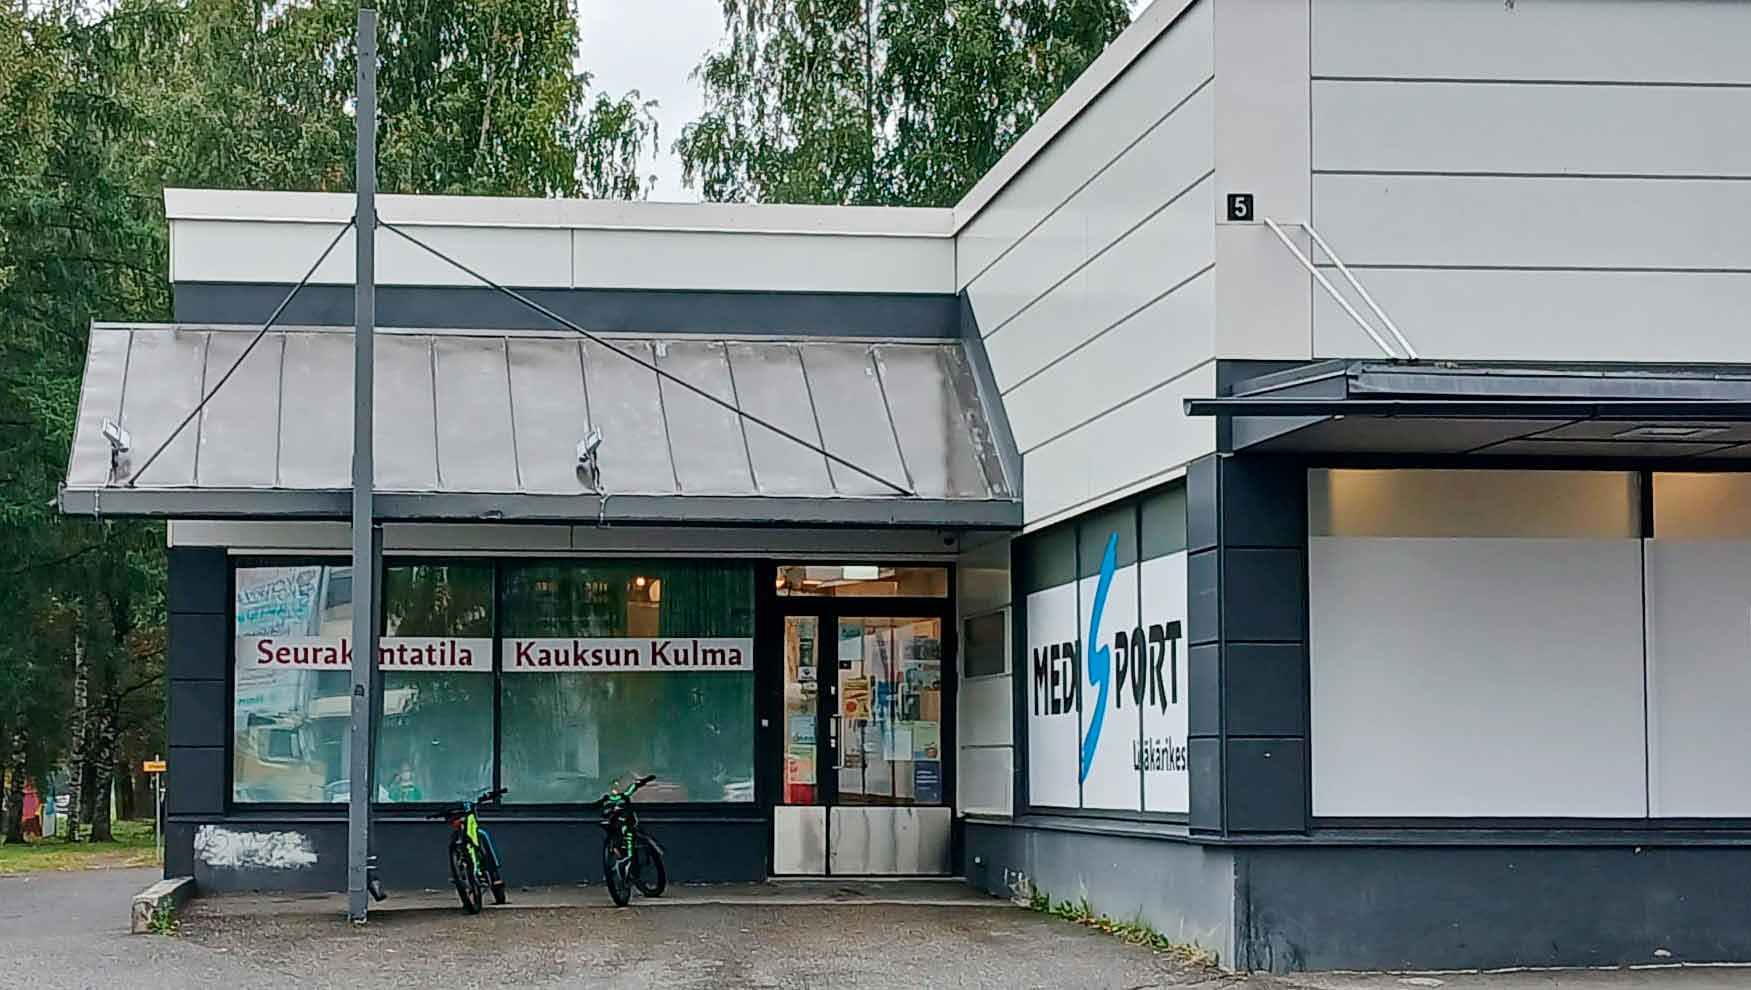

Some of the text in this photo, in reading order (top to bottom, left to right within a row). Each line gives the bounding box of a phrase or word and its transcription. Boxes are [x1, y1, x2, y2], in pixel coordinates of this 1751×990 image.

[1234, 196, 1247, 217] 5
[257, 638, 742, 667] Seurakntatila Kauksun Kulma
